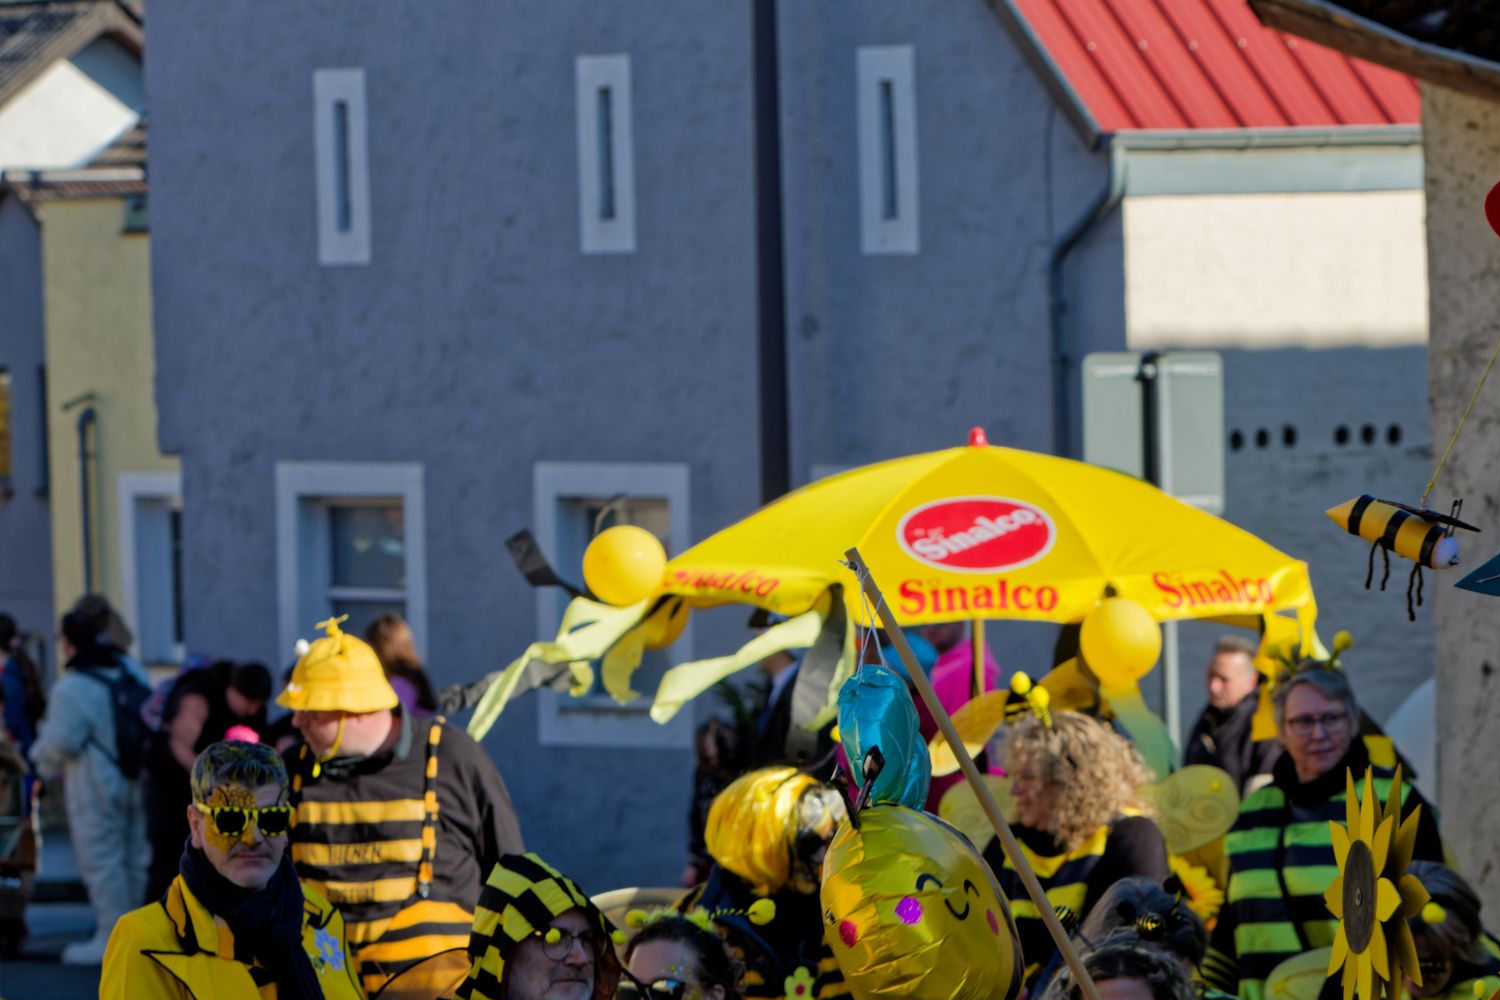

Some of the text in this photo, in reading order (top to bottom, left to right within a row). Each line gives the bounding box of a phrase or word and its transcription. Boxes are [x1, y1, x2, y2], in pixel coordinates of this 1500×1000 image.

[912, 508, 1038, 561] Sinalco
[898, 578, 1059, 616] Sinalco
[1152, 569, 1275, 608] Sinalco
